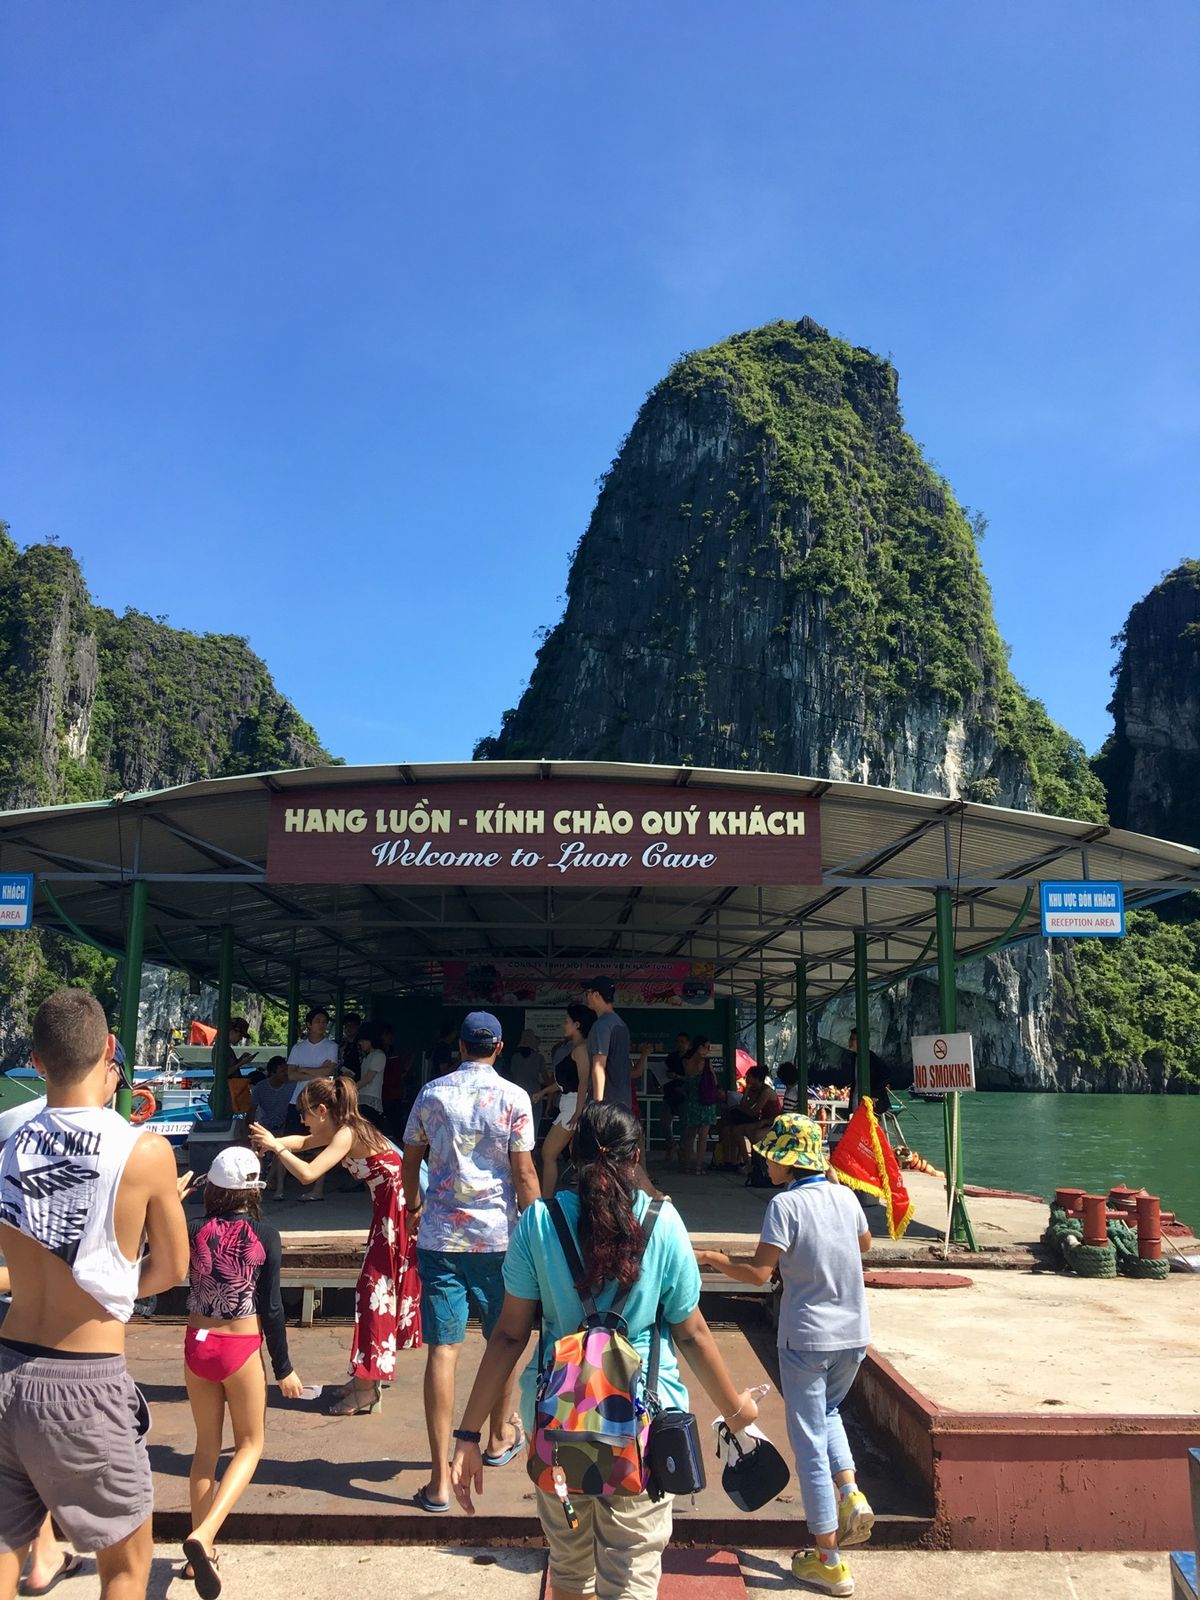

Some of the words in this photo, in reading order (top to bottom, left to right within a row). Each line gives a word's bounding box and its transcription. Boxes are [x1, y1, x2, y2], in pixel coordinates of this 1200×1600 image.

[285, 808, 368, 833] HANG
[376, 798, 452, 833] LUỒN
[459, 818, 468, 826] -
[476, 803, 545, 834] KÍNH
[553, 803, 634, 835] CHÀO
[641, 805, 701, 836] QUÝ
[708, 805, 806, 836] KHÁCH
[371, 838, 503, 867] Welcome
[510, 848, 545, 867] to
[547, 841, 633, 873] Luon
[641, 842, 718, 869] Cave
[1048, 893, 1062, 907] KHU
[1093, 890, 1116, 908] KHÁCH
[0, 910, 21, 920] AREA
[1050, 918, 1093, 927] RECEPTION
[1094, 918, 1115, 927] AREA
[915, 1065, 927, 1088] NO
[930, 1063, 971, 1088] SMOKING
[35, 1131, 60, 1156] THE
[63, 1131, 101, 1156] WALL
[4, 1159, 100, 1199] VANS
